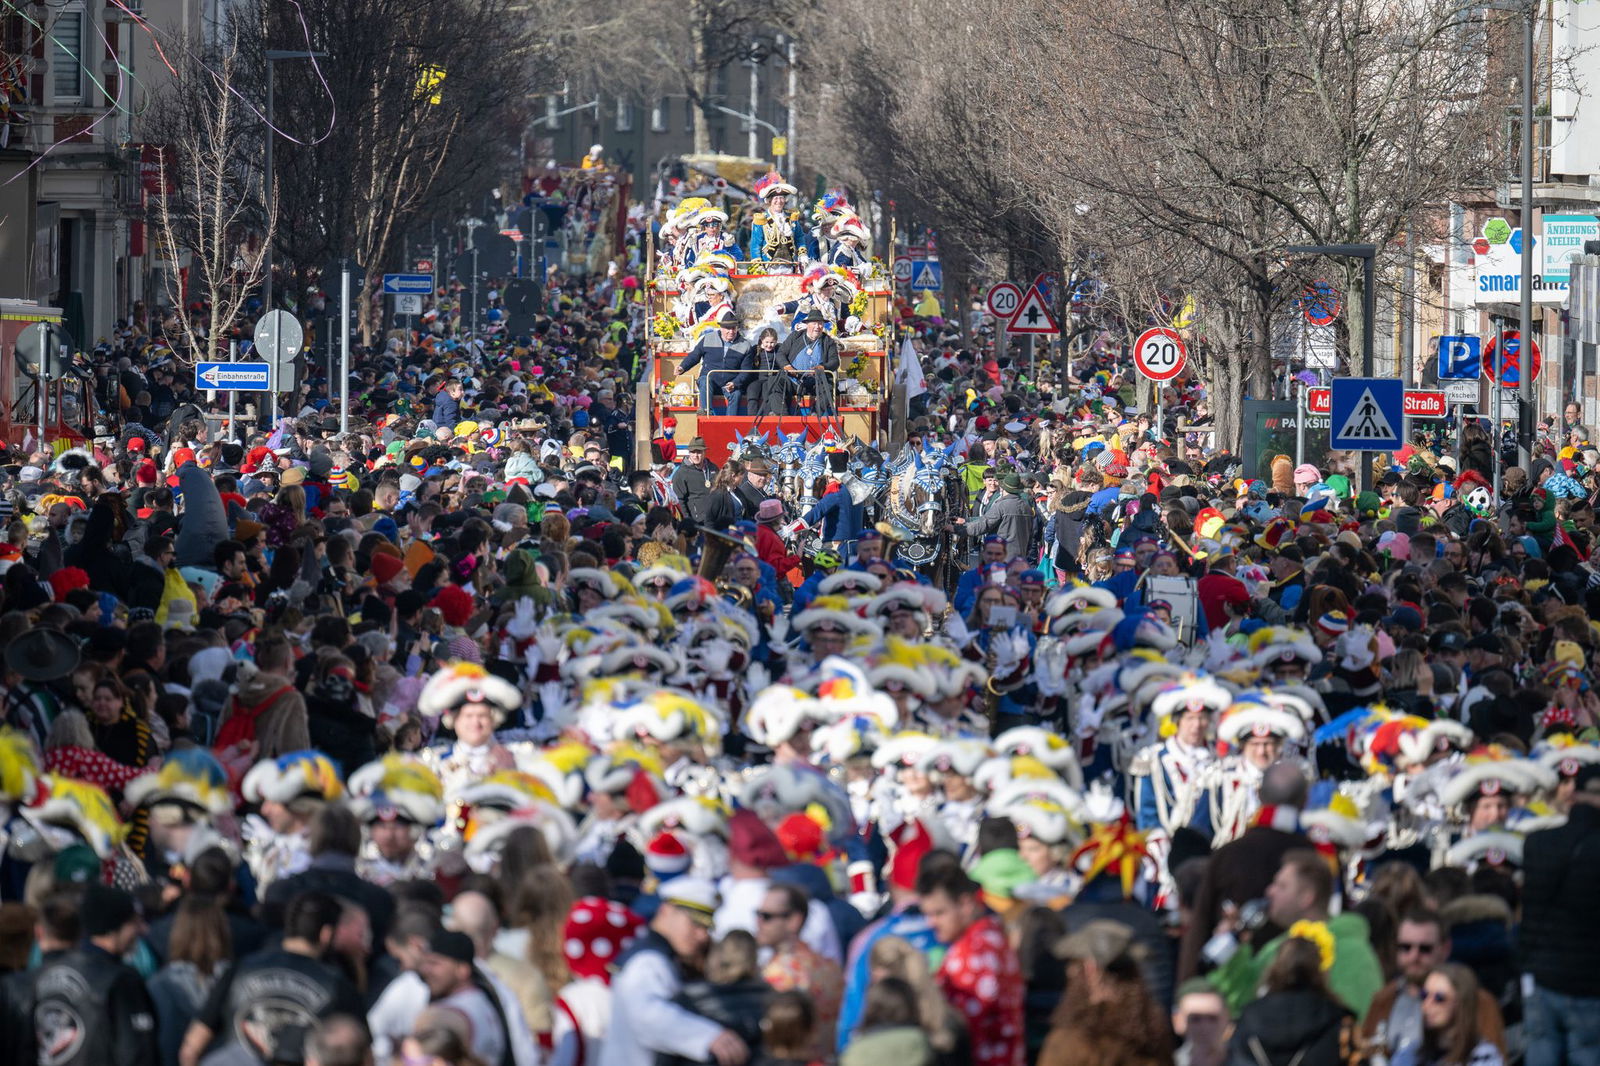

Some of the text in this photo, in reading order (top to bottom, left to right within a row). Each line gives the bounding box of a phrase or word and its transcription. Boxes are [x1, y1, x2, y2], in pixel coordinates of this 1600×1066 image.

[1547, 224, 1597, 235] ÄNDERUNGS
[1547, 237, 1581, 246] ATELIER
[896, 262, 912, 276] 20
[996, 293, 1015, 309] 20
[1146, 343, 1175, 366] 20
[1448, 341, 1471, 373] P
[1316, 394, 1440, 411] Ad Straße
[1281, 418, 1331, 429] PAKSID
